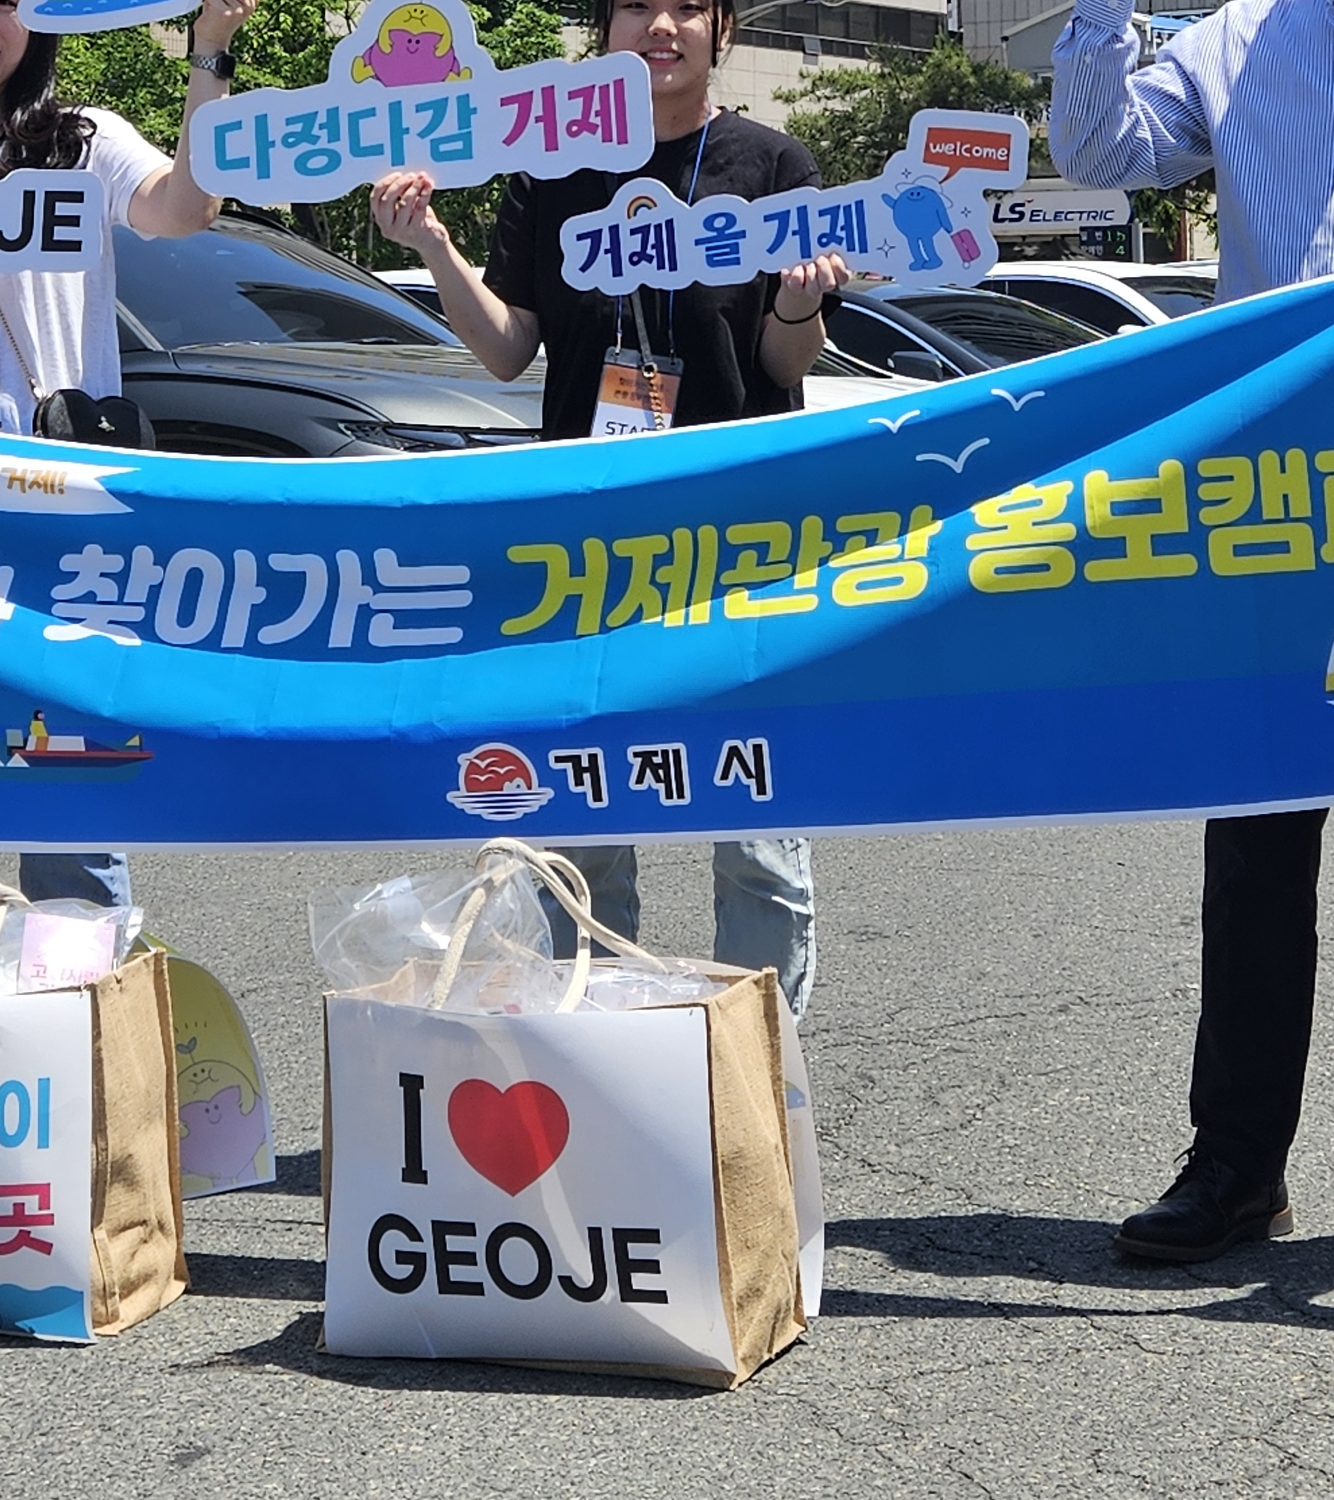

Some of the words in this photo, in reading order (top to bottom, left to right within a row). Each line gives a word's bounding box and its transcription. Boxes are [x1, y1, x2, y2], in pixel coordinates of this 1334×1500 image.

[214, 92, 478, 180] 다정다감
[499, 77, 629, 153] 거제
[928, 139, 1009, 163] welcome
[577, 217, 677, 278] 거제
[695, 211, 747, 268] 올
[765, 199, 869, 260] 거제
[992, 200, 1027, 224] LS
[1029, 209, 1115, 222] ELECTRIC
[605, 421, 658, 435] STA
[0, 467, 68, 496] 거제!
[42, 543, 473, 649] 찾아가는
[498, 503, 946, 639] 거제관광
[398, 1071, 429, 1186] I
[367, 1212, 669, 1305] GEOJE
